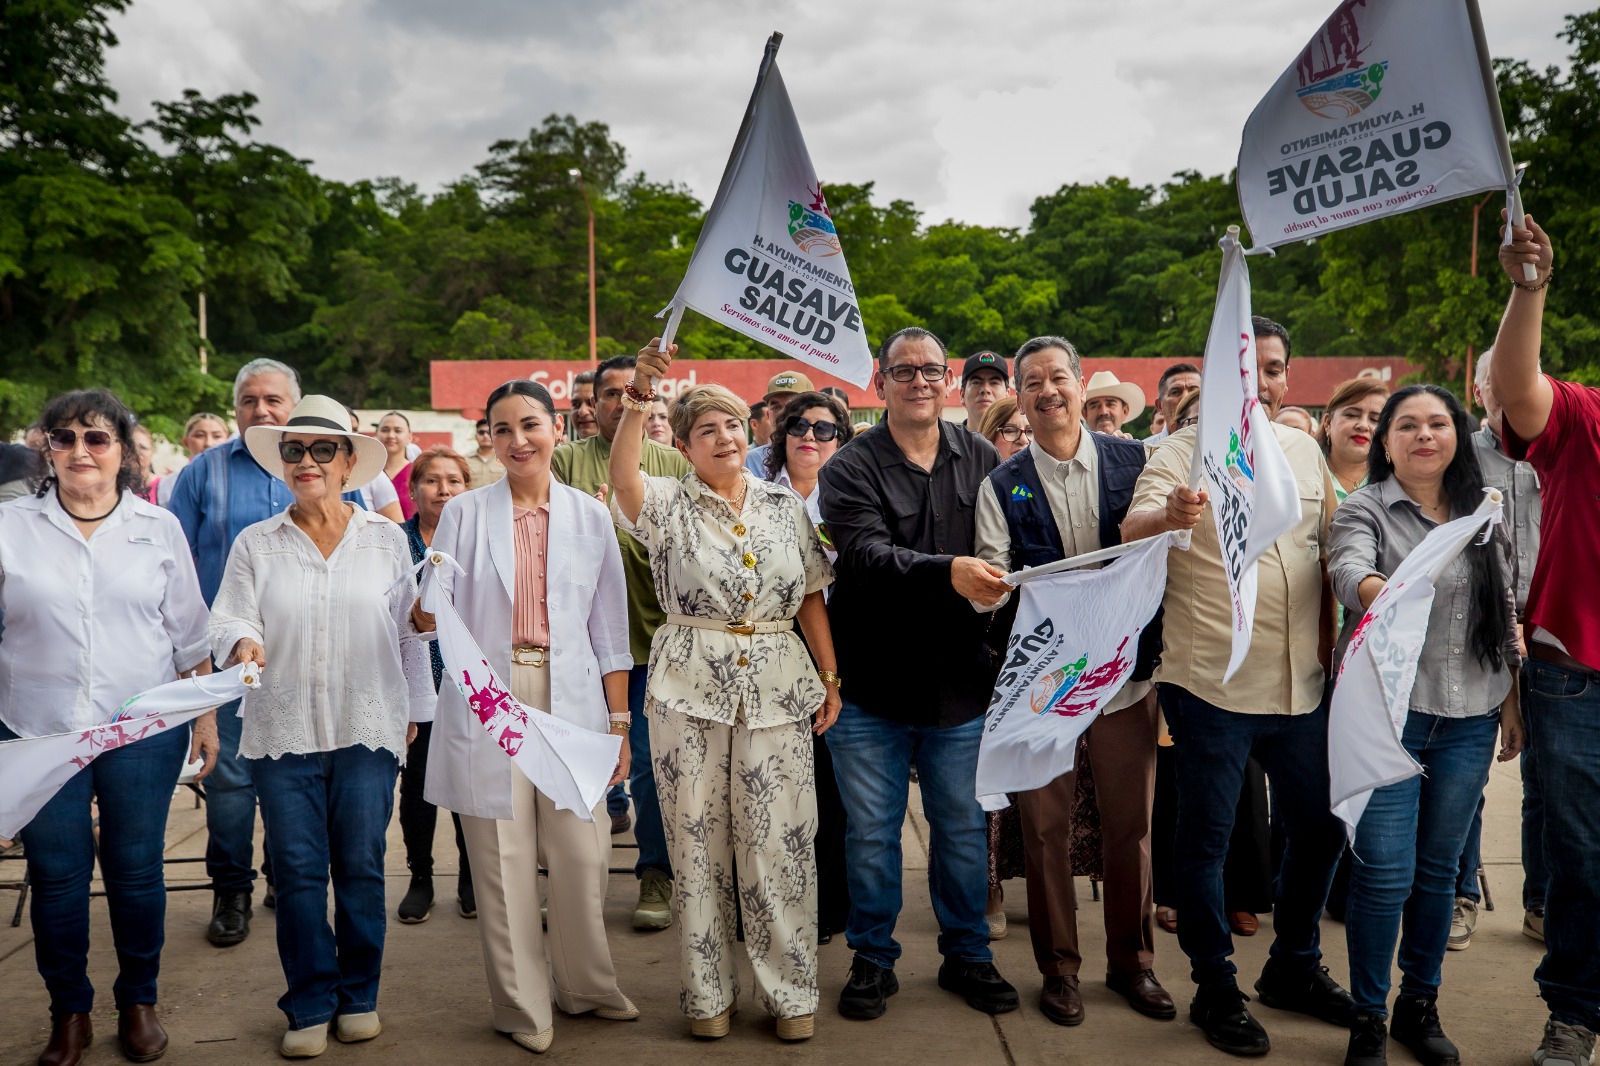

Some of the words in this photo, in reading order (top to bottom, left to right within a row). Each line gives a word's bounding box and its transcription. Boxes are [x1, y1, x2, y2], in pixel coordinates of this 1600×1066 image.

[724, 247, 861, 332] GUASAVE
[753, 234, 765, 249] H.
[766, 242, 854, 294] AYUNTAMIENTO
[784, 263, 818, 283] 2024-2027
[720, 303, 761, 329] Servimos
[761, 324, 776, 336] con
[776, 332, 800, 346] amor
[800, 342, 810, 352] al
[810, 345, 840, 364] pueblo
[739, 286, 836, 346] SALUD
[988, 649, 1060, 732] AYUNTAMIENTO
